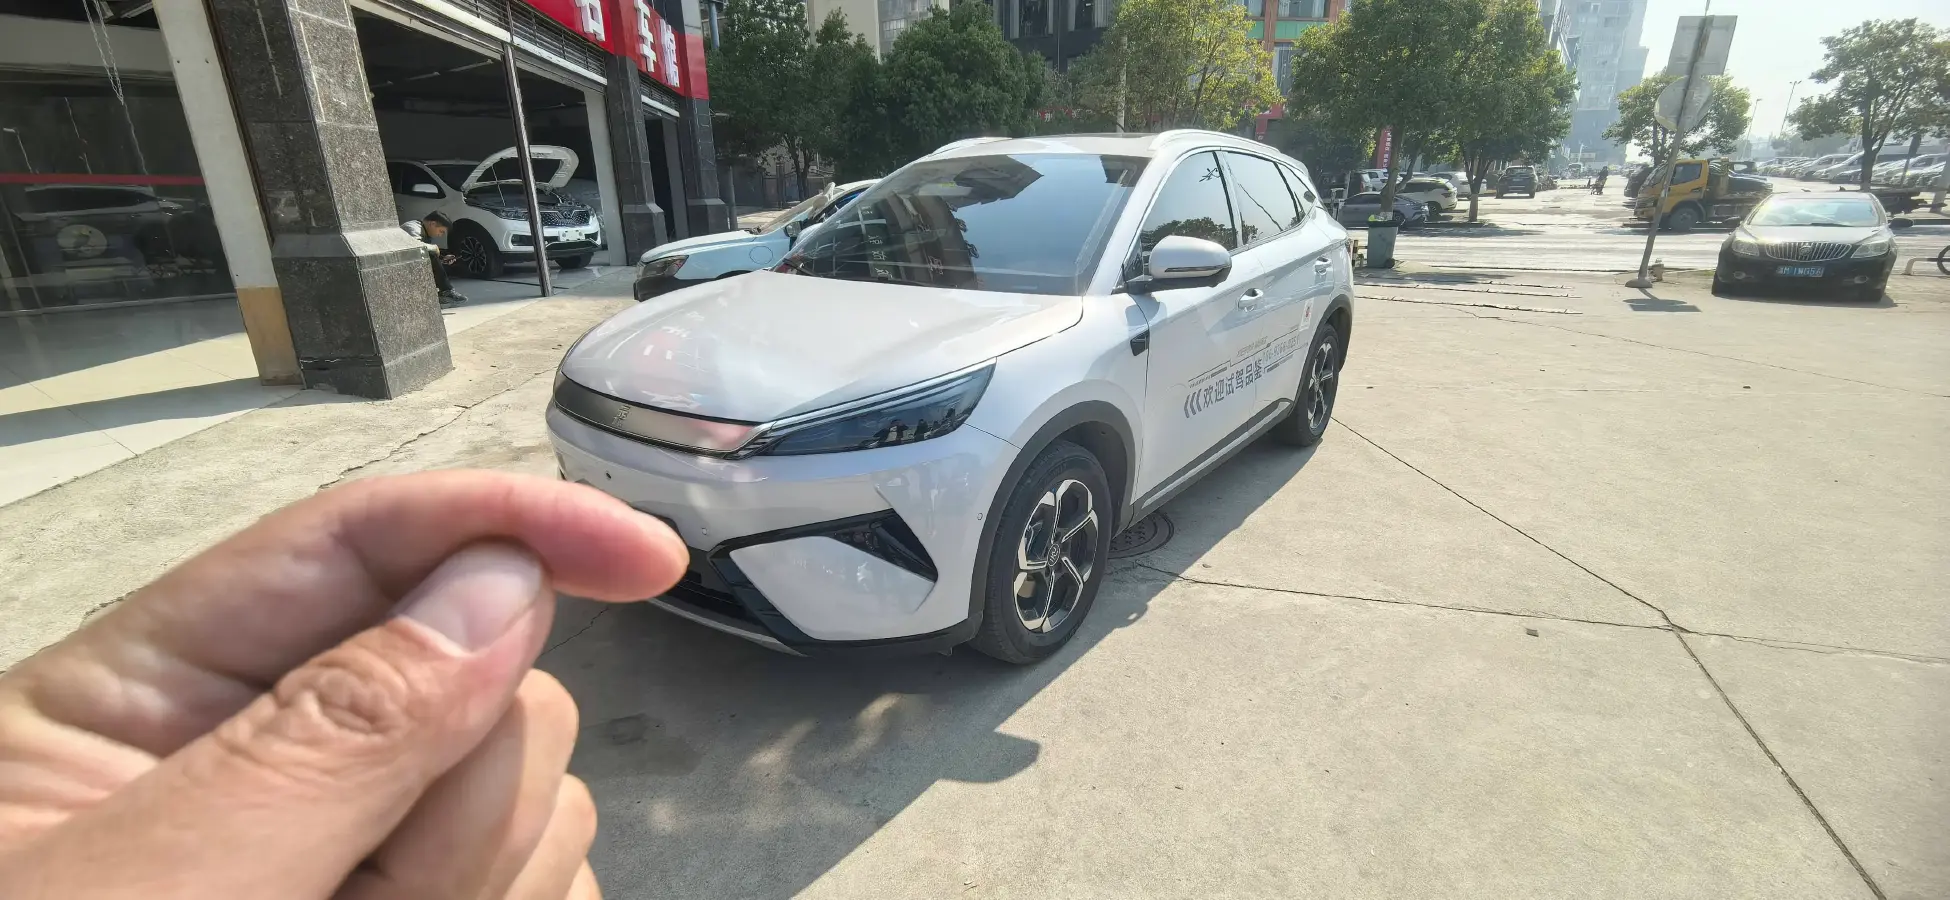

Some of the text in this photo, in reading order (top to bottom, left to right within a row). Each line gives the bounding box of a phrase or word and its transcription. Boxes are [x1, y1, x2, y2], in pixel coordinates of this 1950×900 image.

[1203, 359, 1262, 408] 欢迎试驾品鉴
